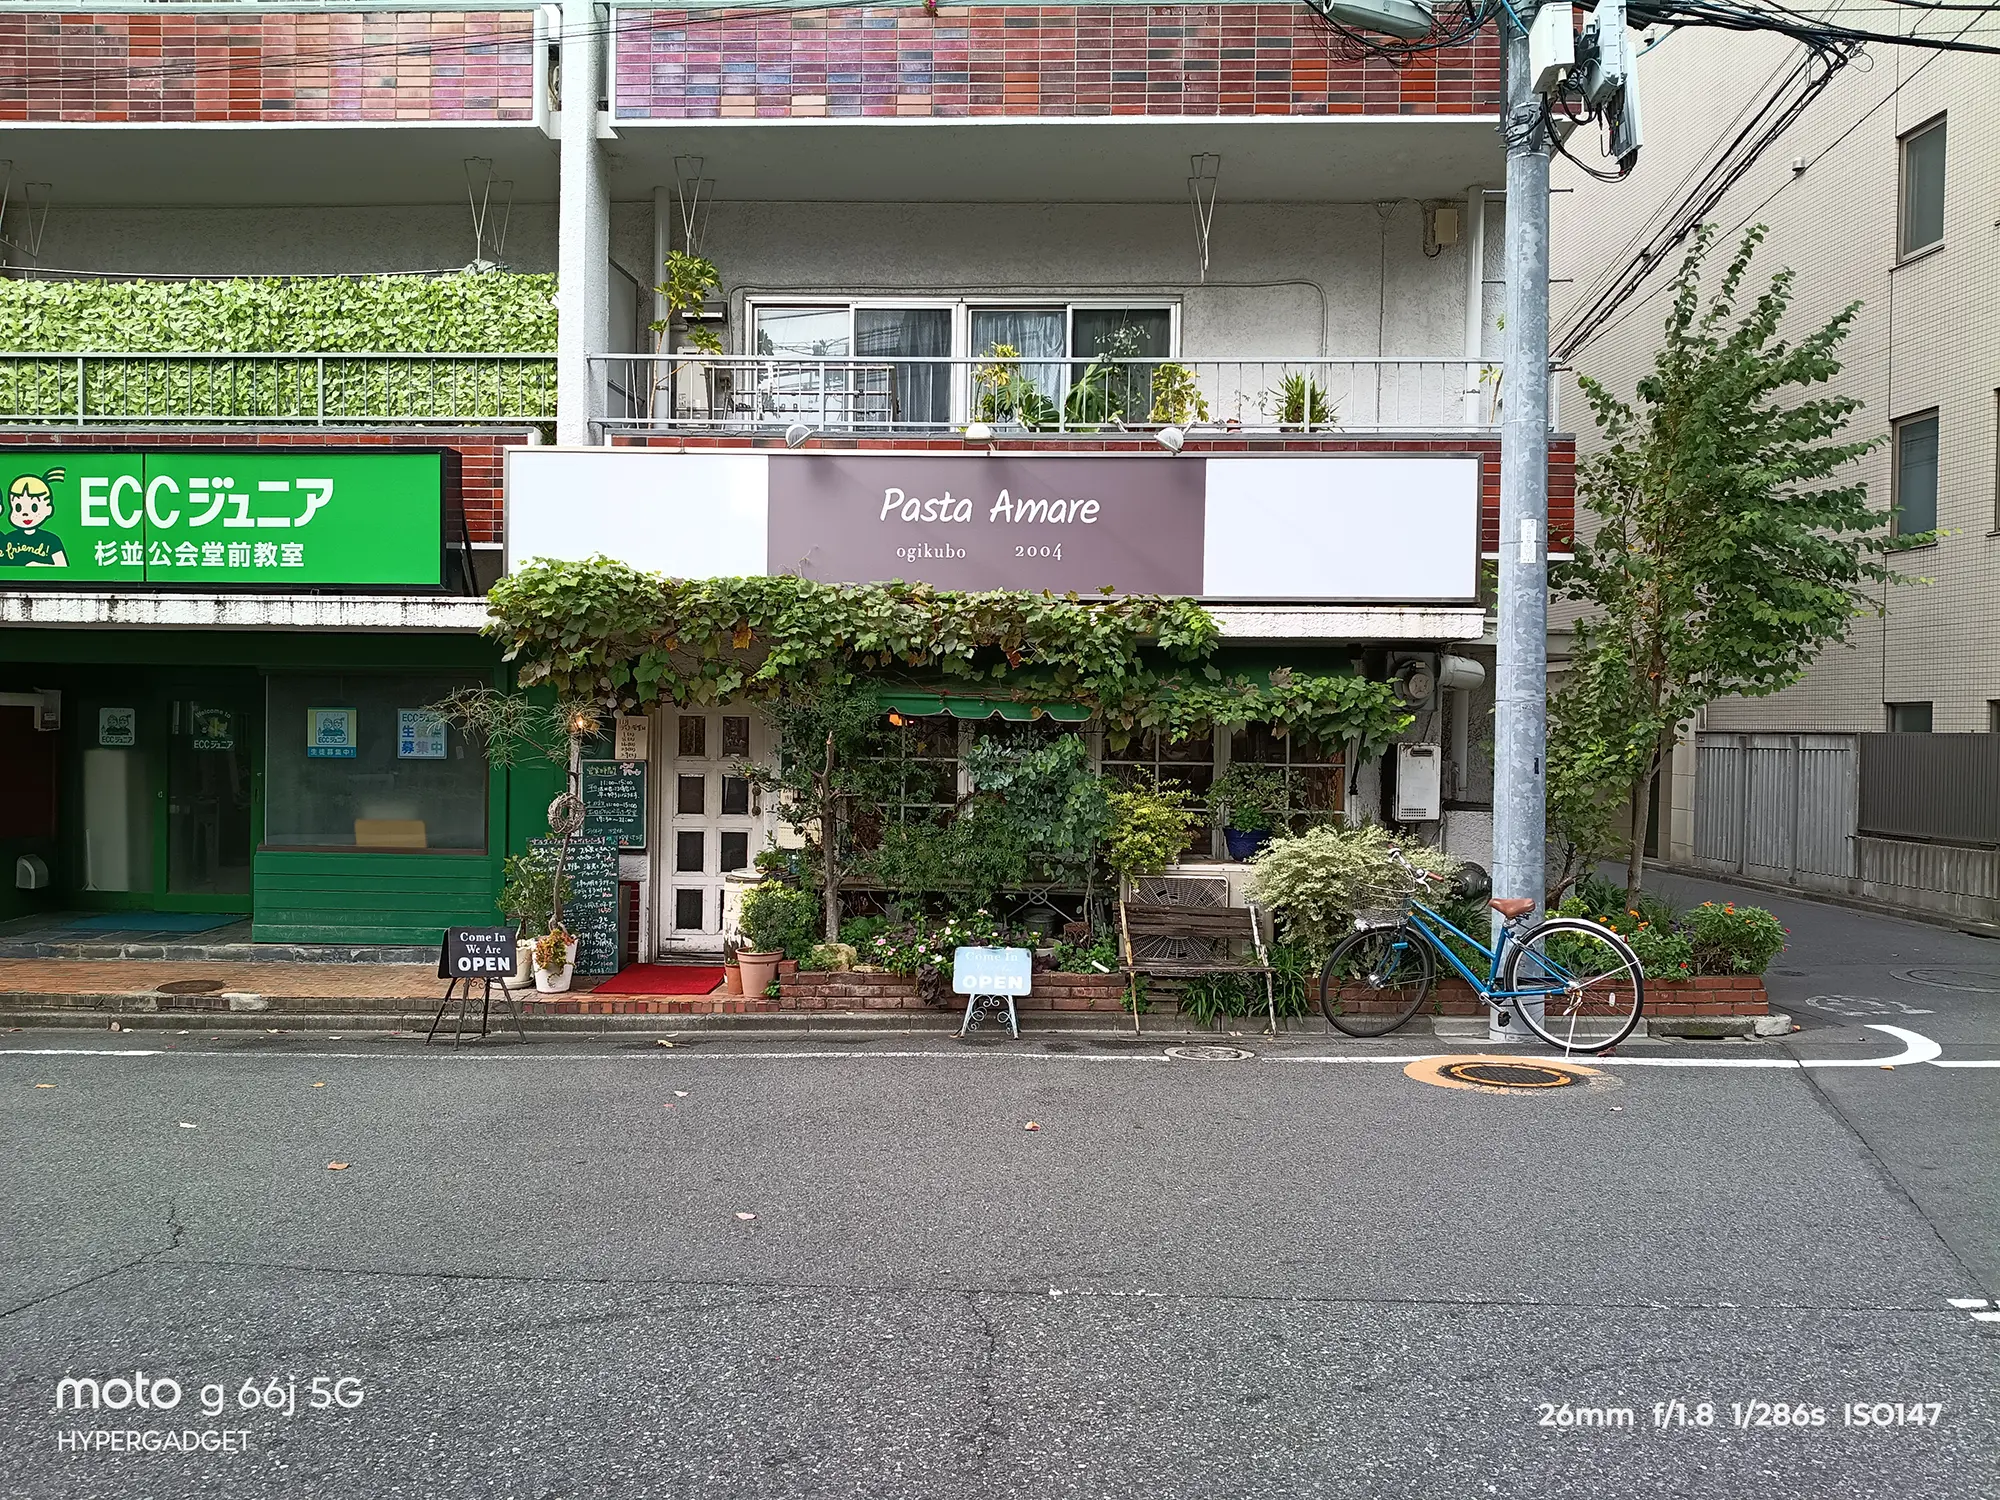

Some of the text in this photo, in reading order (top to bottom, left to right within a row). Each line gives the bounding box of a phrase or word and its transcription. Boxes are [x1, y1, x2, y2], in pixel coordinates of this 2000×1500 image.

[80, 475, 335, 529] ECCジュニア
[879, 487, 1101, 524] Pasta Amare
[94, 540, 305, 568] 杉並公会堂前教室
[896, 542, 1063, 563] ogikubo 2004
[195, 708, 224, 718] Welcome
[194, 739, 234, 749] ECCジュニア
[401, 738, 443, 752] 募集中
[460, 932, 507, 942] Come In
[465, 944, 501, 954] We Are
[965, 951, 1018, 962] Come In
[457, 956, 511, 972] OPEN
[962, 974, 1023, 990] OPEN
